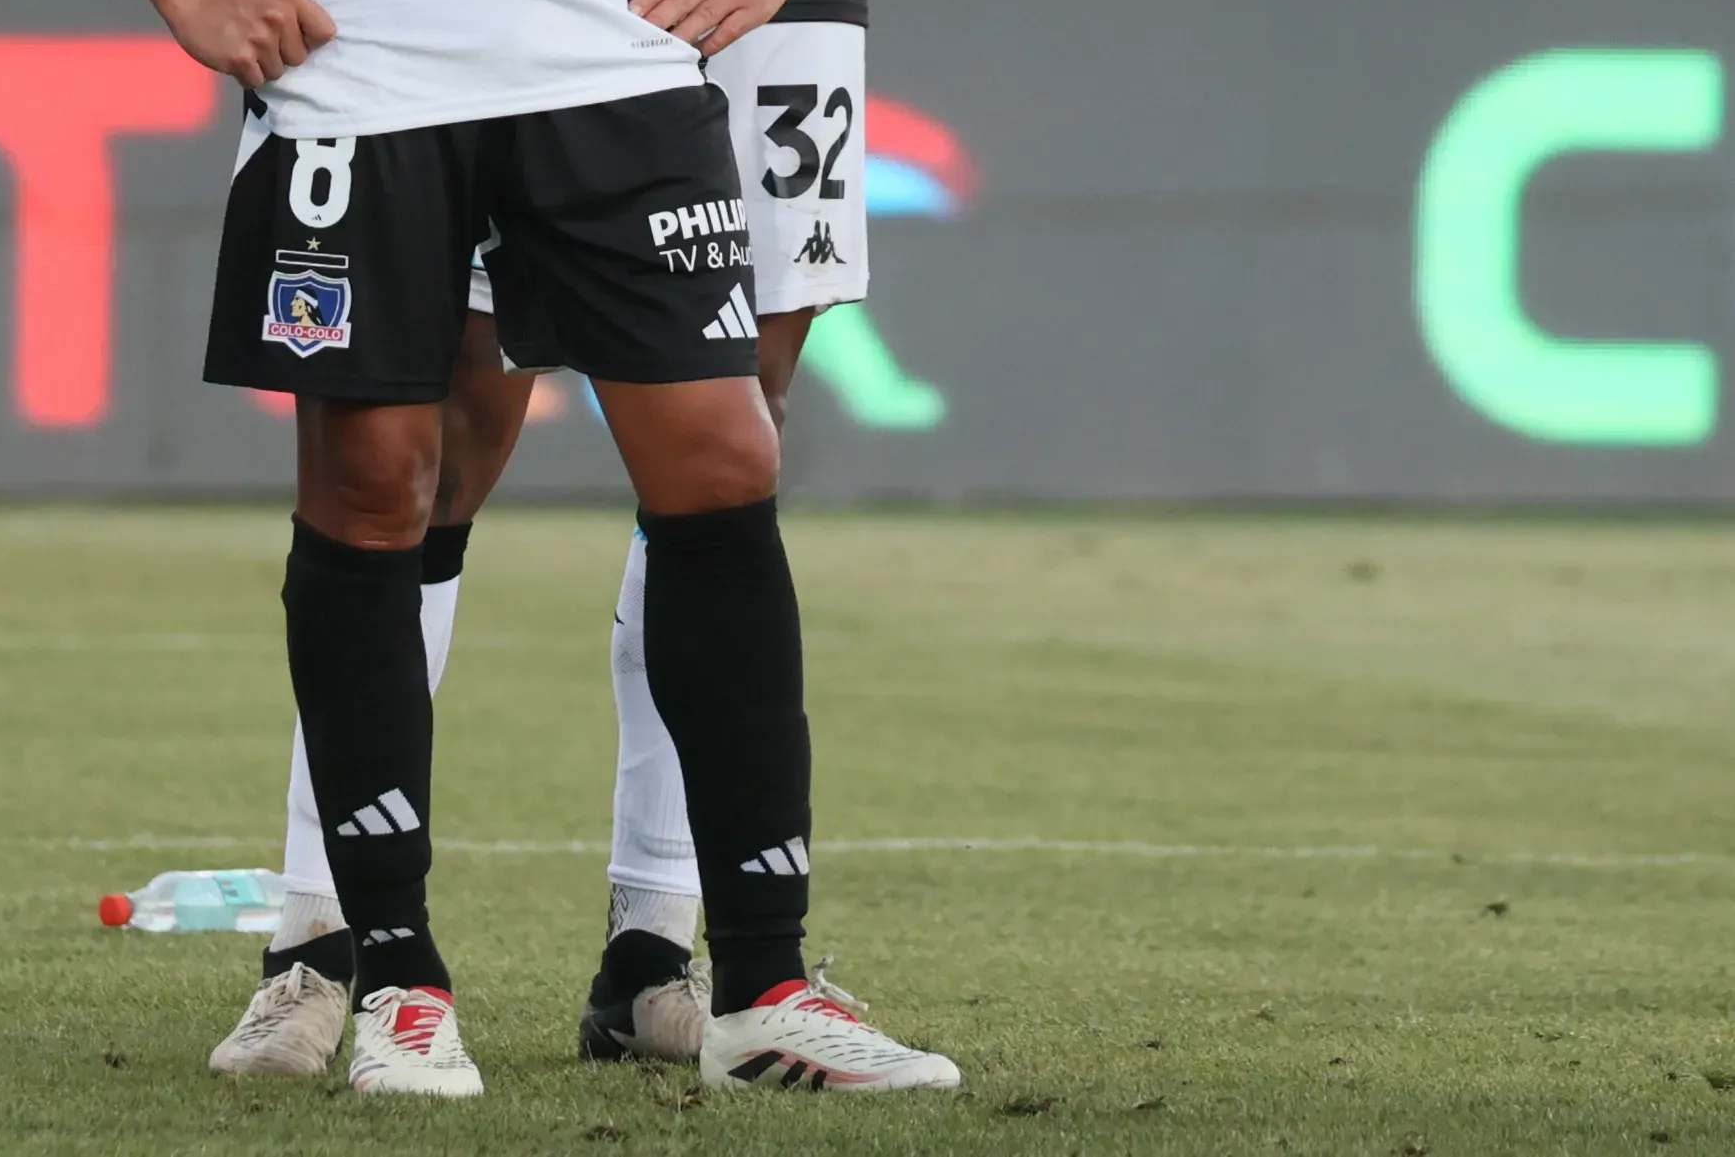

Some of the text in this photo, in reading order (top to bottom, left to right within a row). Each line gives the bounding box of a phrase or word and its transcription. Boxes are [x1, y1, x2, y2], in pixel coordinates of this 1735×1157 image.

[756, 83, 853, 200] 32
[288, 136, 357, 228] 8
[659, 244, 697, 272] TV
[707, 241, 725, 269] &
[270, 324, 342, 340] COLO-COLO
